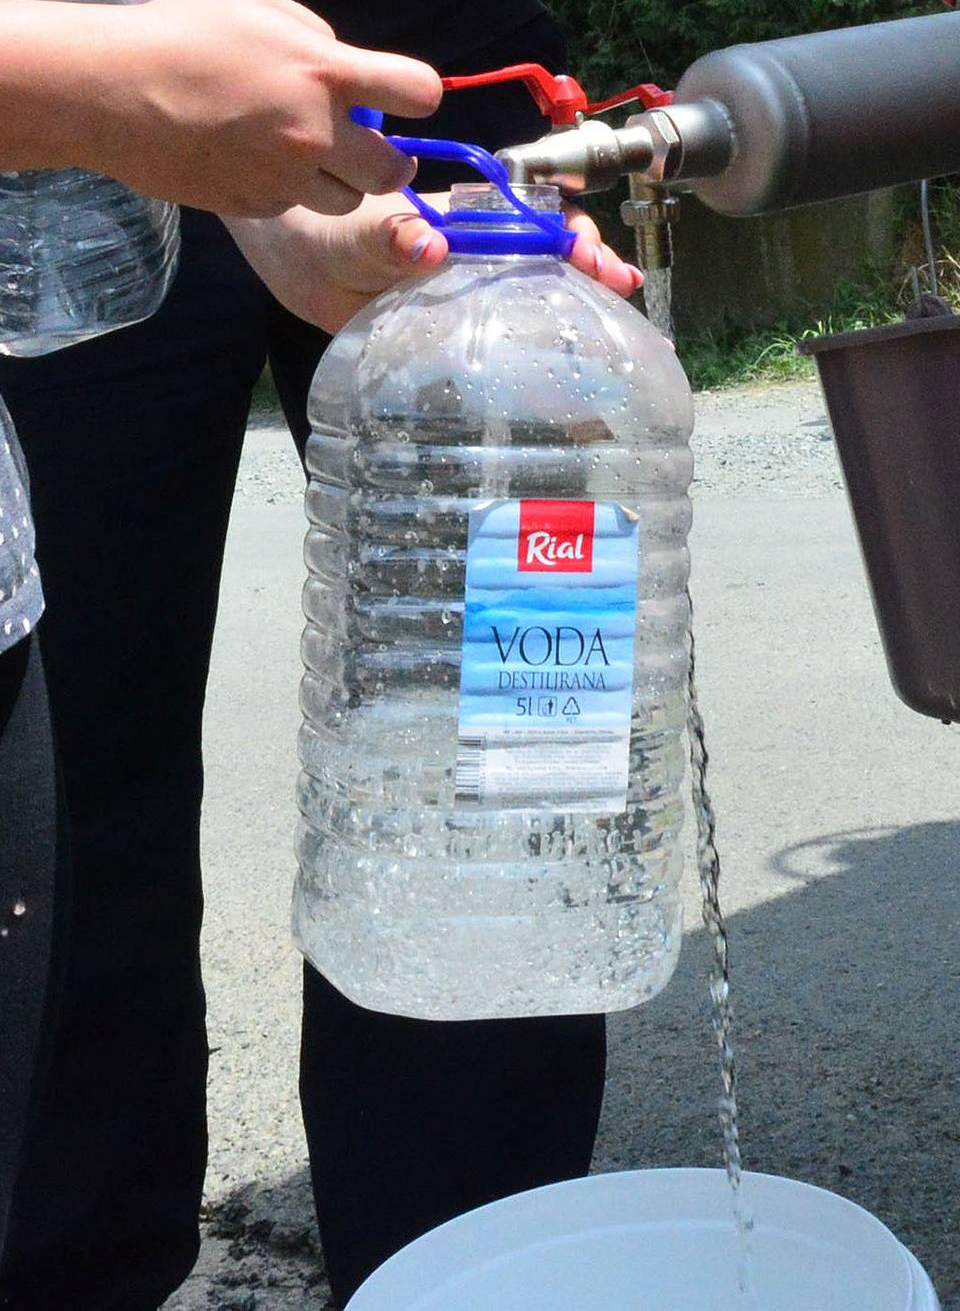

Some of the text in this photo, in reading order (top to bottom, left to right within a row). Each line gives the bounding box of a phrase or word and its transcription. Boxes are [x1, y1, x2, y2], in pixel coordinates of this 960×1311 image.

[526, 531, 584, 566] Rial
[489, 626, 610, 666] VODA
[498, 670, 606, 691] DESTILIRANA
